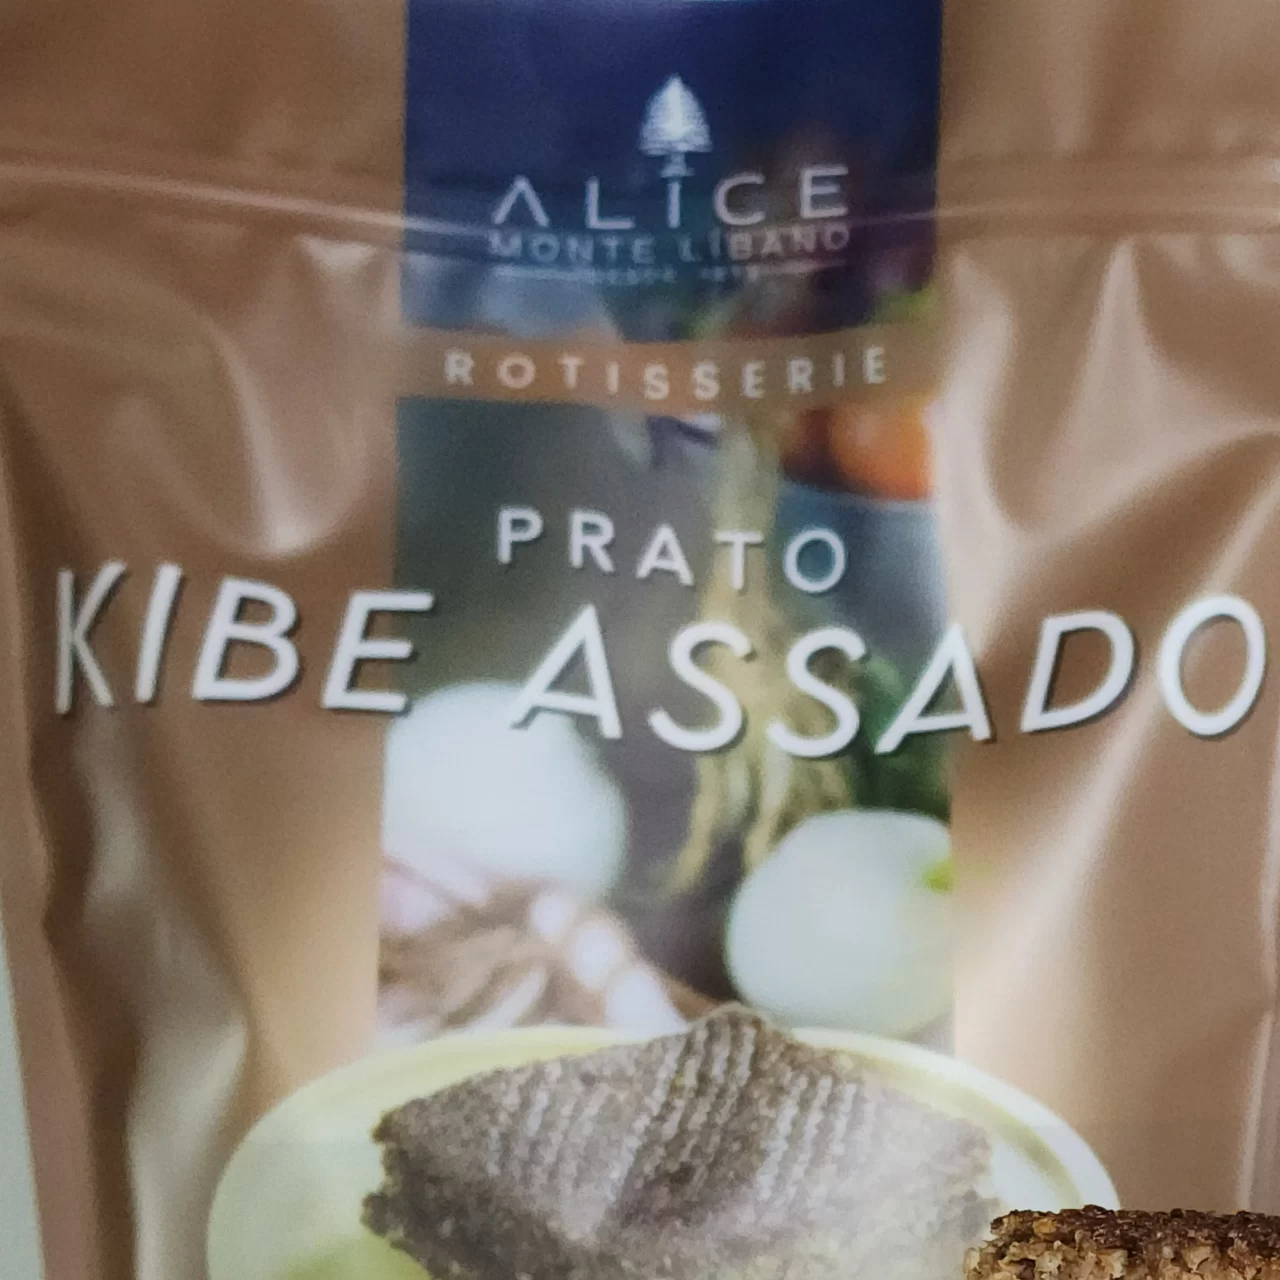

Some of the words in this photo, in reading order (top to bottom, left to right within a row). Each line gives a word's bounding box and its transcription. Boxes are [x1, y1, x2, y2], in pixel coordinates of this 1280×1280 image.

[491, 165, 849, 231] ALICE
[488, 229, 655, 264] MONTE
[677, 223, 850, 263] LIBANO
[444, 344, 889, 401] ROTISSERIE
[497, 506, 846, 594] PRATO
[53, 559, 436, 717] KIBE
[508, 594, 1269, 760] ASSADO
